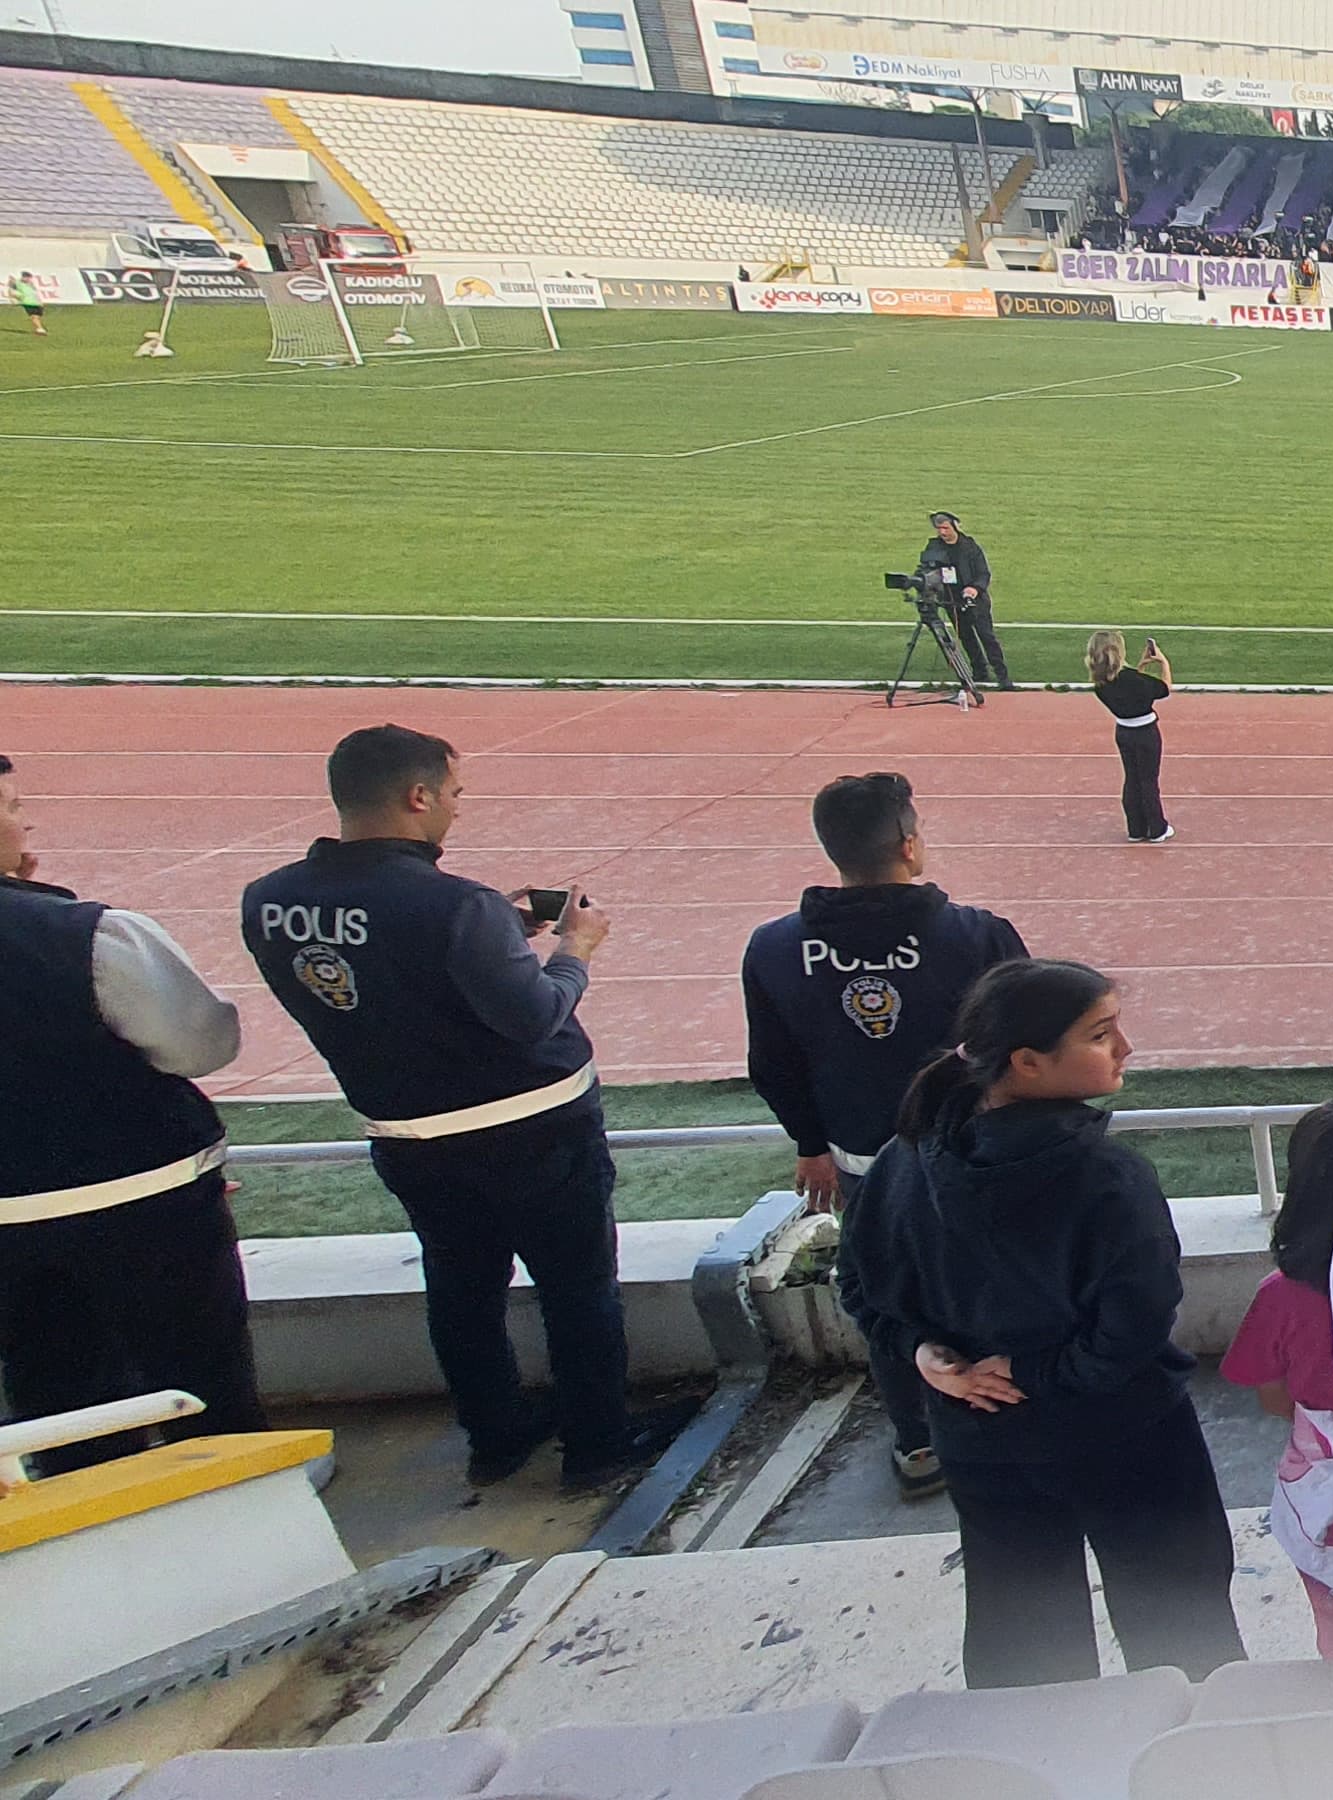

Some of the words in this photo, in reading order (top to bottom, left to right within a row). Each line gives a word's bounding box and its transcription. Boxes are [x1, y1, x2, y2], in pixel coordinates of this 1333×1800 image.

[1101, 72, 1137, 91] AHM
[1119, 299, 1166, 322] Lider
[261, 902, 369, 946] POLIS
